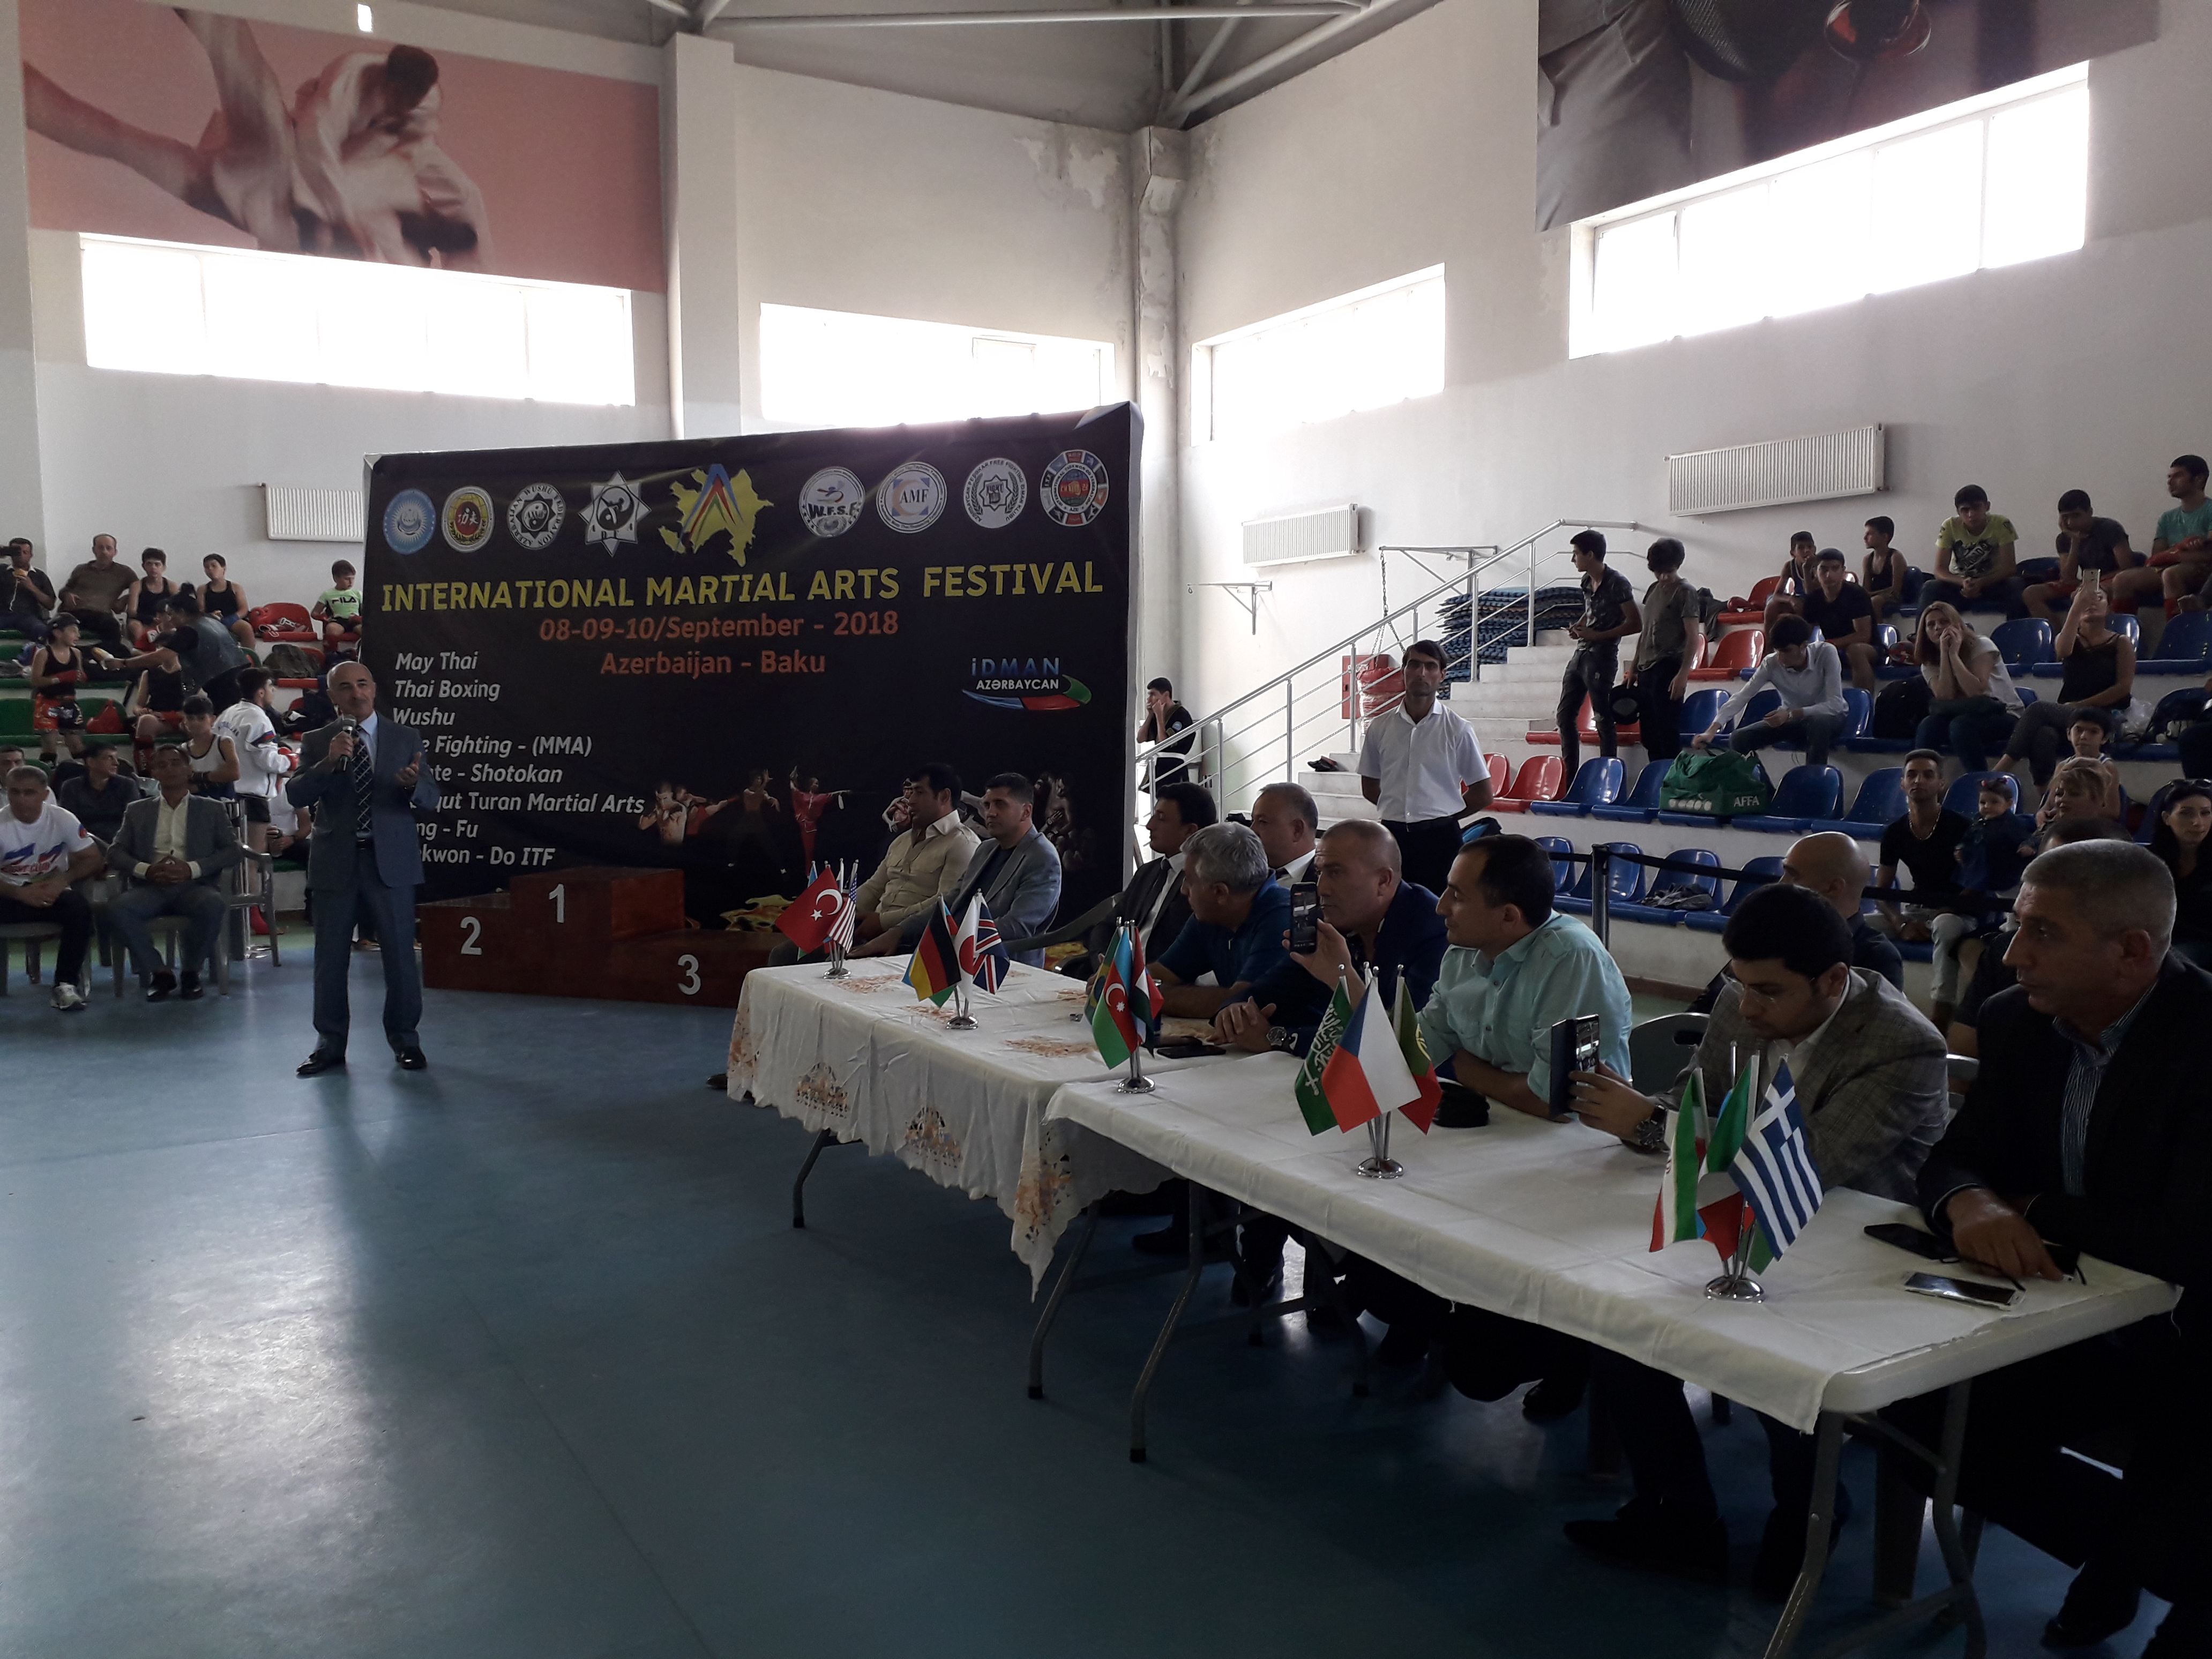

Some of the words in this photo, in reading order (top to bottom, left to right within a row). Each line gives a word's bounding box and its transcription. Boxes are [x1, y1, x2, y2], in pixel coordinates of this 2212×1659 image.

[900, 489, 929, 504] AMF
[382, 578, 634, 611] INTERNATIONAL
[646, 572, 795, 606] MARTIAL
[807, 567, 899, 600] ARTS
[923, 561, 1103, 597] FESTIVAL
[332, 596, 357, 604] FILA
[539, 613, 804, 642] 08-09-10/September
[833, 610, 899, 636] 2018
[395, 653, 435, 675] May
[440, 651, 479, 670] Thai
[600, 651, 731, 680] Azerbaijan
[761, 649, 825, 673] Baku
[395, 679, 435, 698] Thai
[438, 679, 501, 701] Boxing
[976, 679, 1059, 690] AZƏRBAYCAN
[393, 707, 455, 726] Wushu
[435, 735, 512, 758] Fighting
[532, 736, 592, 757] (MMA)
[470, 763, 563, 783] Shotokan
[468, 791, 522, 811] Turan
[527, 793, 597, 812] Martial
[600, 794, 645, 813] Arts
[1733, 795, 1760, 808] AFFA
[416, 823, 437, 841] ng
[456, 819, 479, 838] Fu
[420, 843, 470, 863] kwon
[490, 846, 515, 865] Do
[521, 847, 556, 866] ITF
[549, 884, 565, 923] 1
[460, 916, 482, 955] 2
[677, 954, 701, 995] 3
